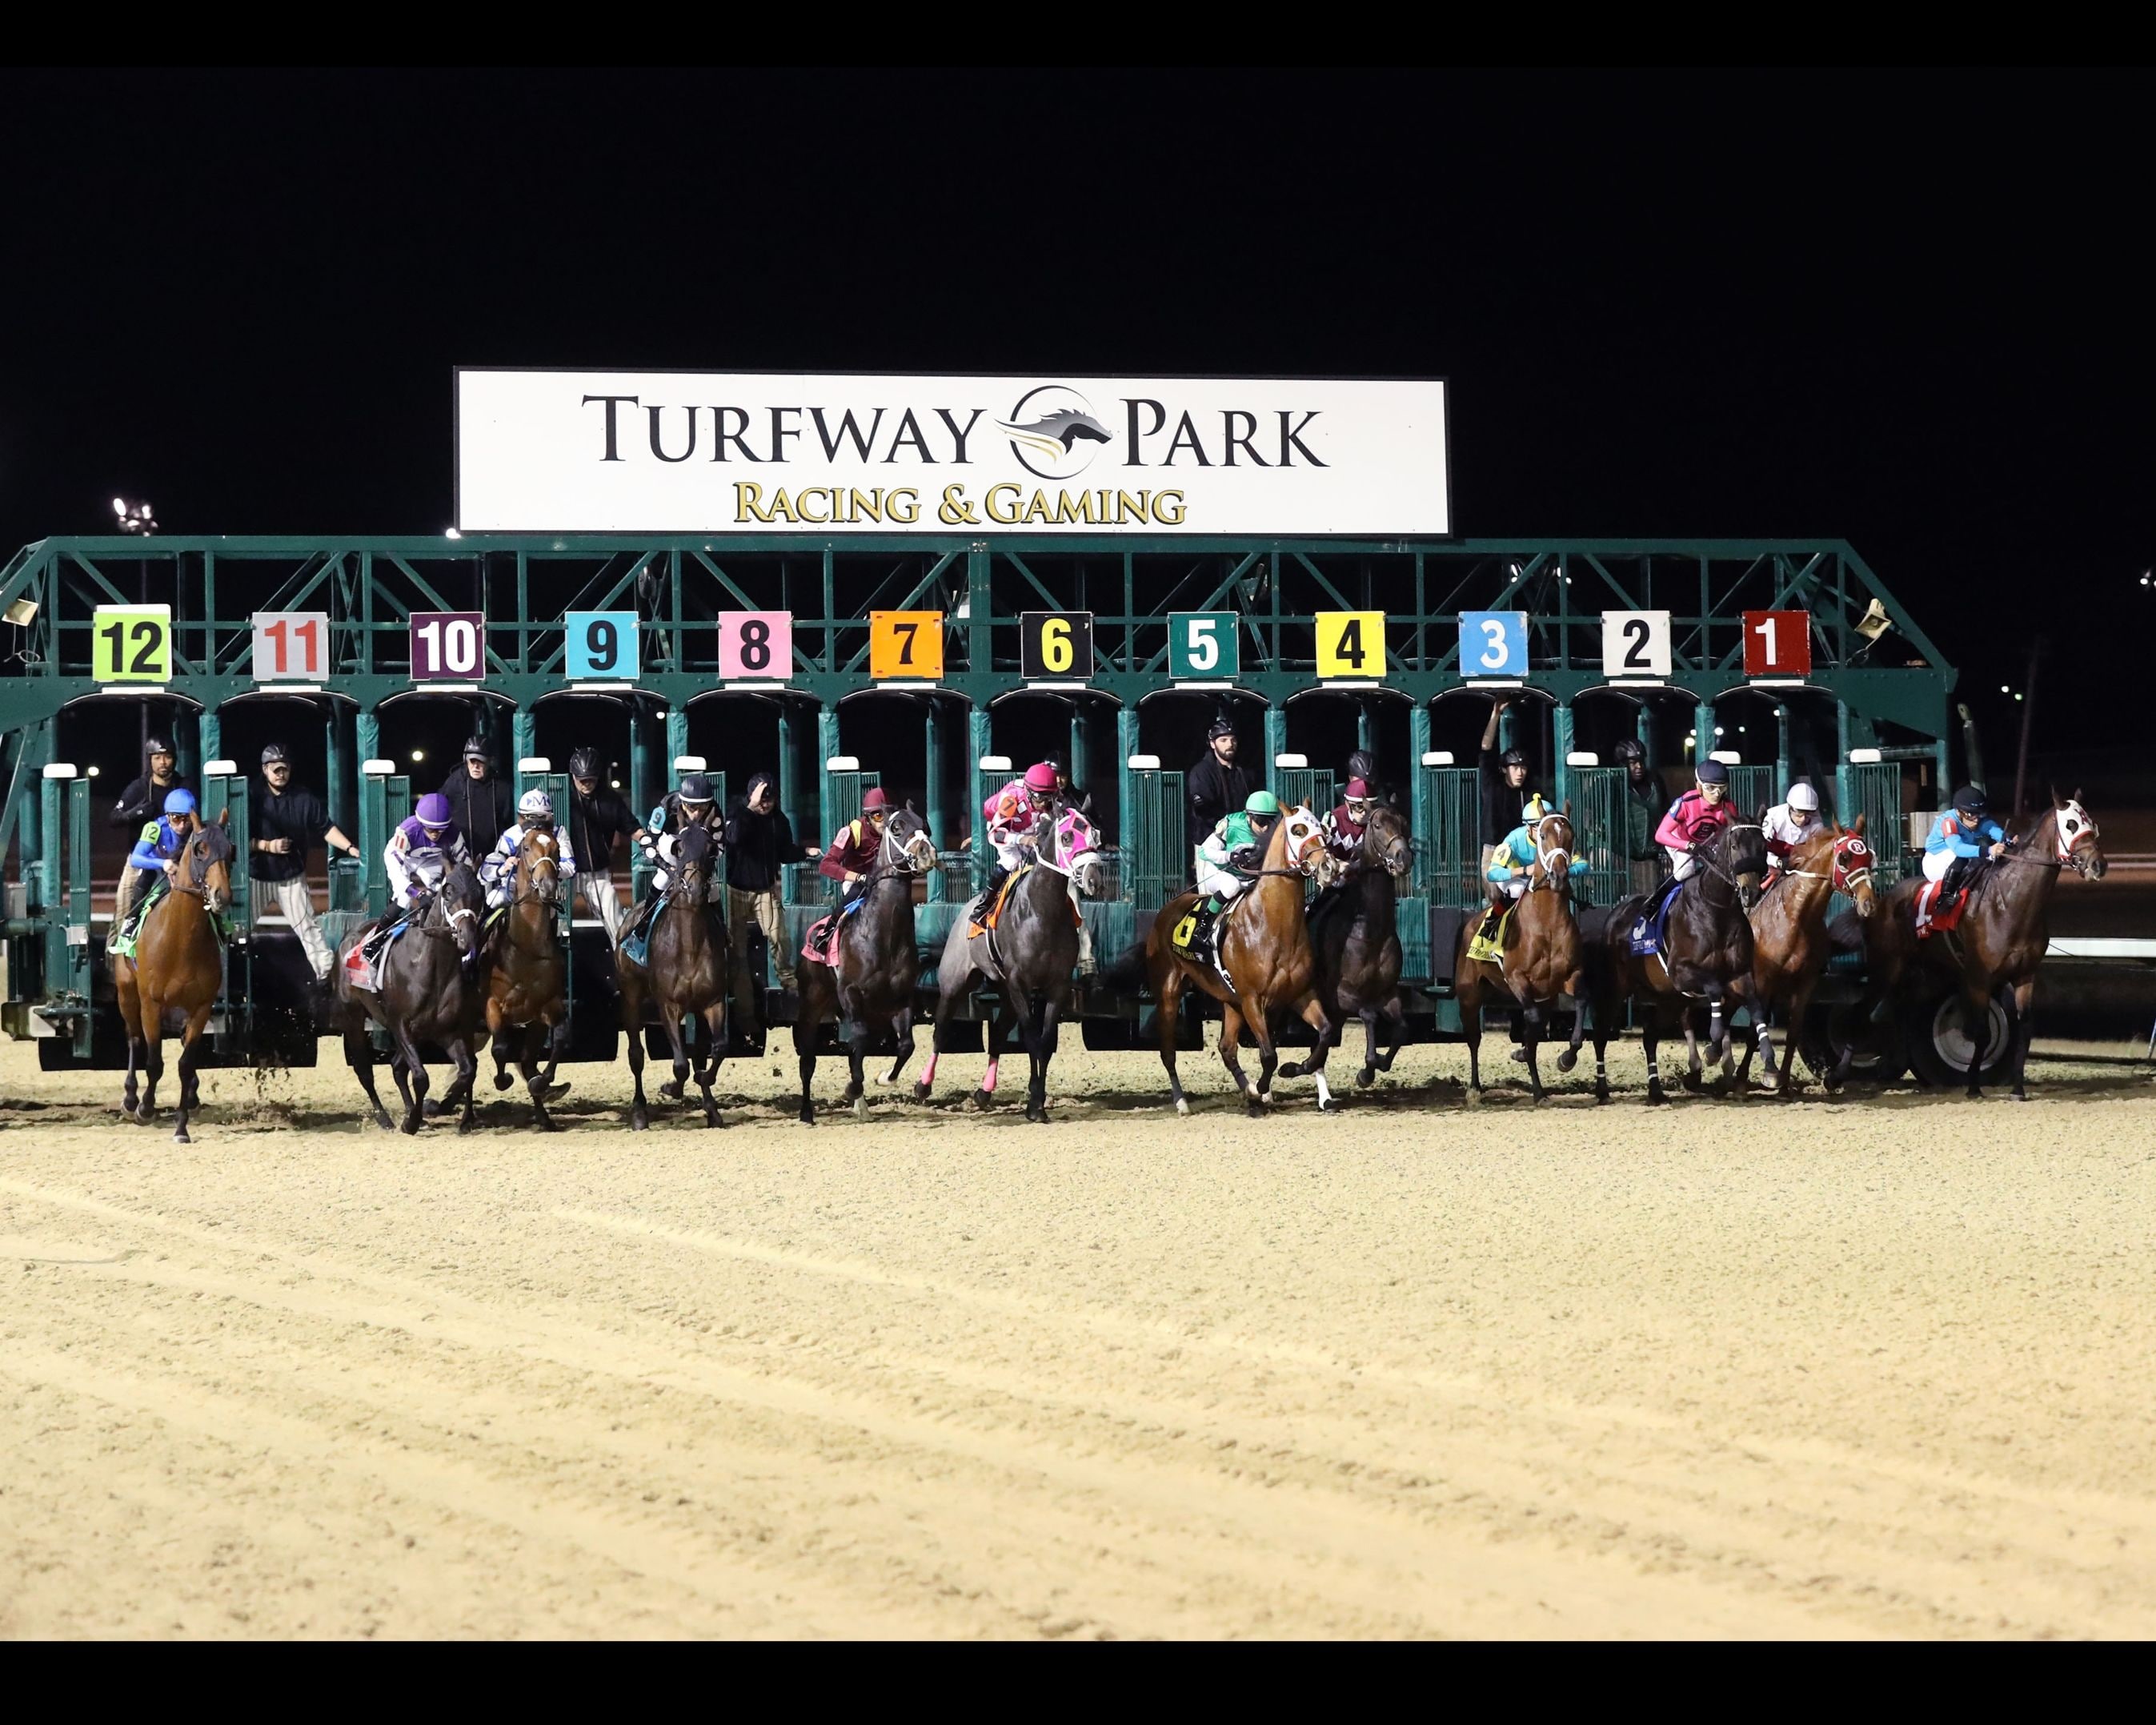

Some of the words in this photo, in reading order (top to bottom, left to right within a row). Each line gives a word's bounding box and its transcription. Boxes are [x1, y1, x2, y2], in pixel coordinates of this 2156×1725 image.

[582, 395, 988, 463] TURFWAY
[1119, 399, 1331, 467] PARK
[733, 482, 922, 524] RACING
[938, 483, 982, 525] &
[984, 483, 1188, 525] GAMING
[102, 621, 162, 673] 12
[264, 620, 317, 672] 11
[418, 620, 476, 672] 10
[587, 620, 618, 671] 9
[739, 620, 771, 670] 8
[893, 623, 919, 664] 7
[1041, 619, 1073, 672] 6
[1188, 619, 1219, 670] 5
[1336, 620, 1365, 669] 4
[1480, 619, 1509, 668] 3
[1623, 619, 1652, 668] 2
[1755, 618, 1777, 665] 1
[144, 825, 158, 840] 12
[395, 835, 405, 849] 11
[652, 812, 662, 825] 9
[1497, 848, 1507, 860] 4
[1853, 842, 1863, 852] R
[1916, 881, 1936, 928] 1
